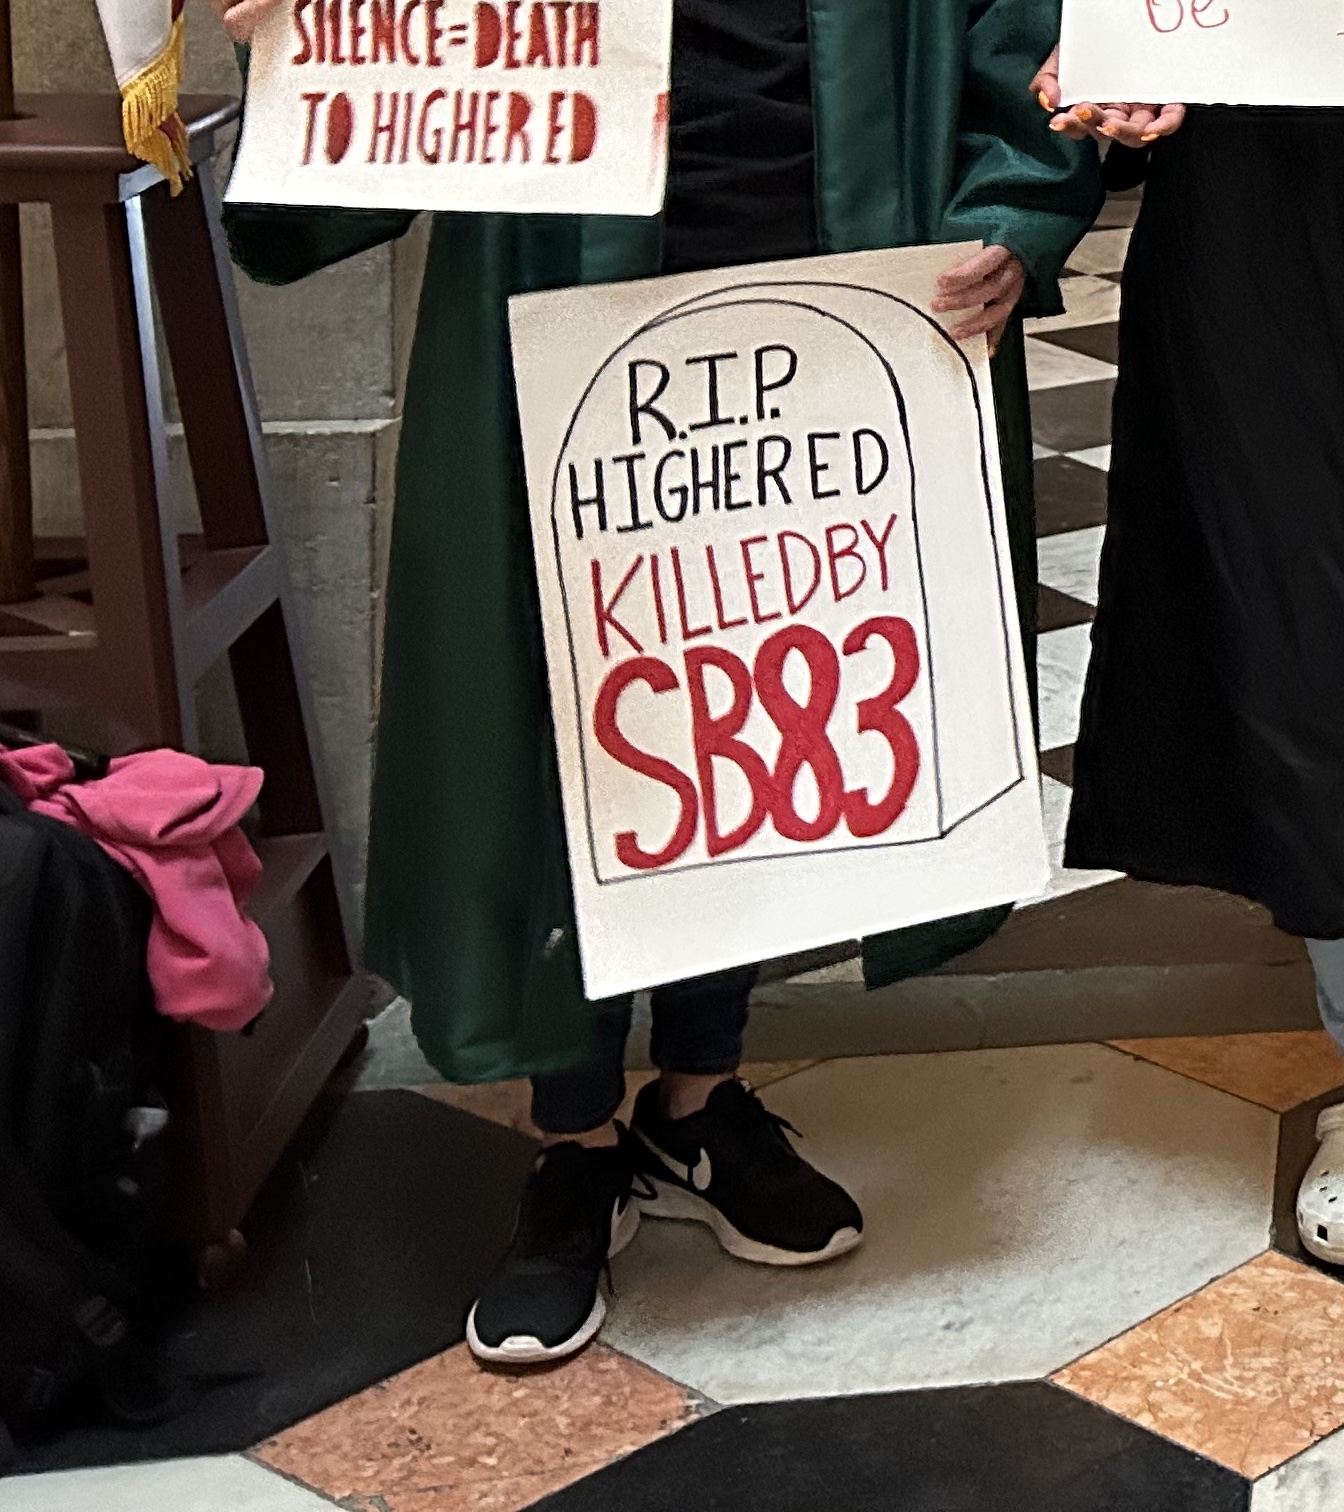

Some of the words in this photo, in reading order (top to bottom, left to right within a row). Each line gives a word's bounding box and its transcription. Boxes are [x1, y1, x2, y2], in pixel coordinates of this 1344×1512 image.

[300, 90, 355, 166] TO
[366, 89, 532, 166] HIGHER
[545, 90, 600, 165] ED
[592, 615, 921, 871] SB83
